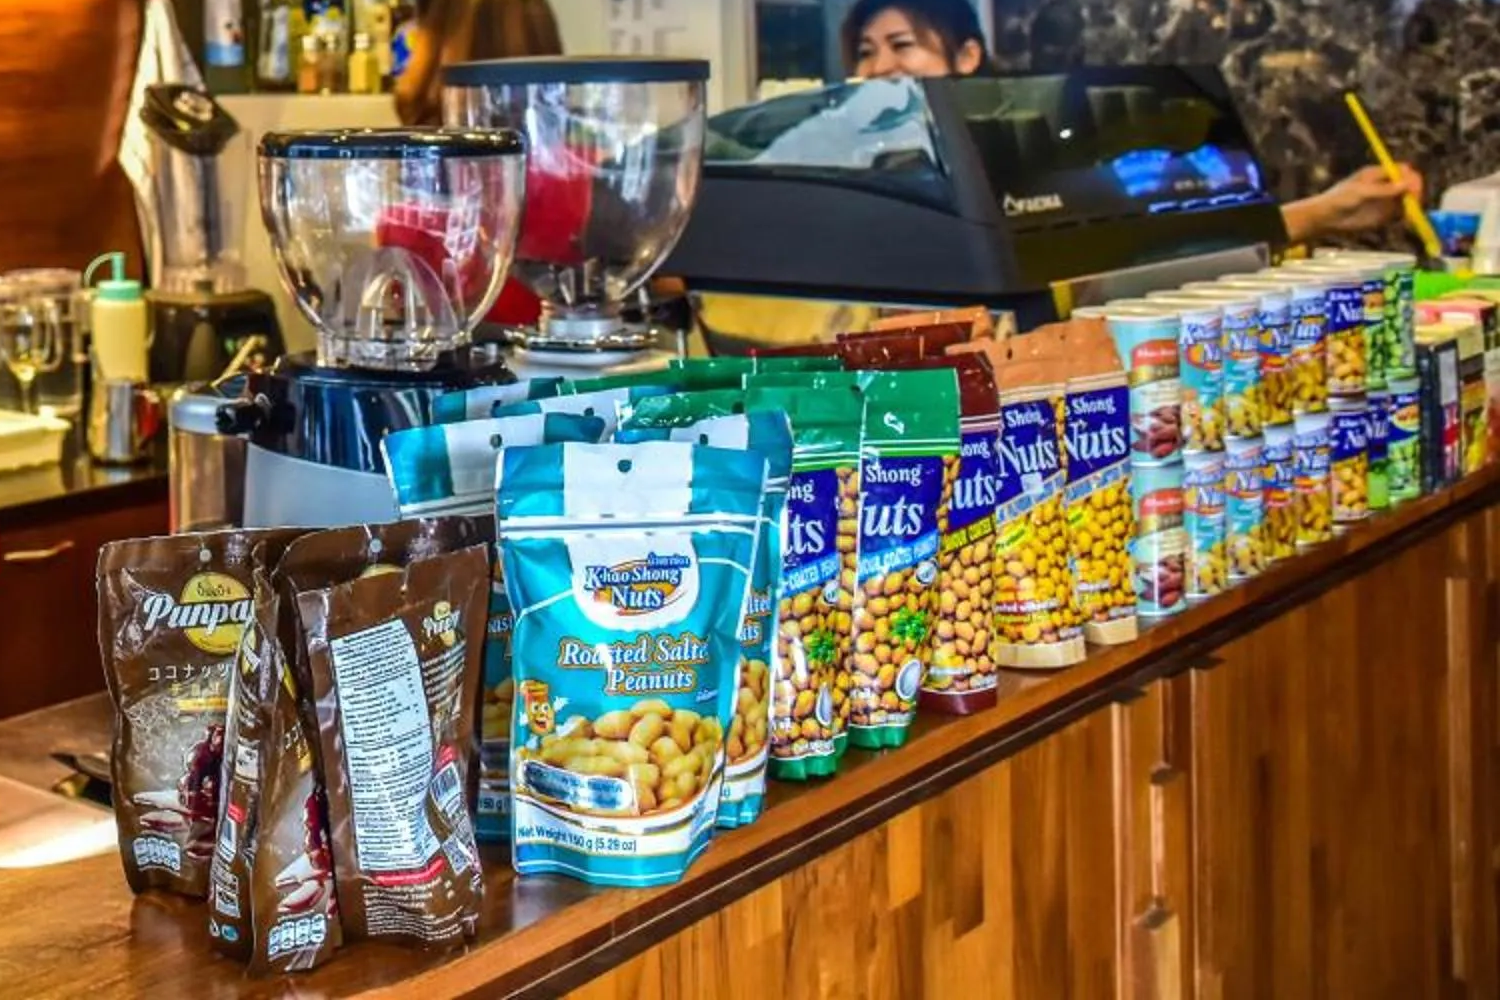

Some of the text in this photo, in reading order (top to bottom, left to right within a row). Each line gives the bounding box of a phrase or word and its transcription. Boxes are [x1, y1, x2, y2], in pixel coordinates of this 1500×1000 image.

[961, 440, 990, 458] ong
[1064, 422, 1125, 462] Nuts
[998, 435, 1058, 478] Nuts
[865, 464, 922, 487] Shong
[787, 480, 816, 503] ng
[950, 468, 996, 511] uts
[861, 493, 925, 537] uts
[586, 566, 681, 589] Khao Shong
[611, 586, 662, 609] Nuts
[562, 639, 647, 666] Roasted
[609, 668, 693, 691] Peanuts
